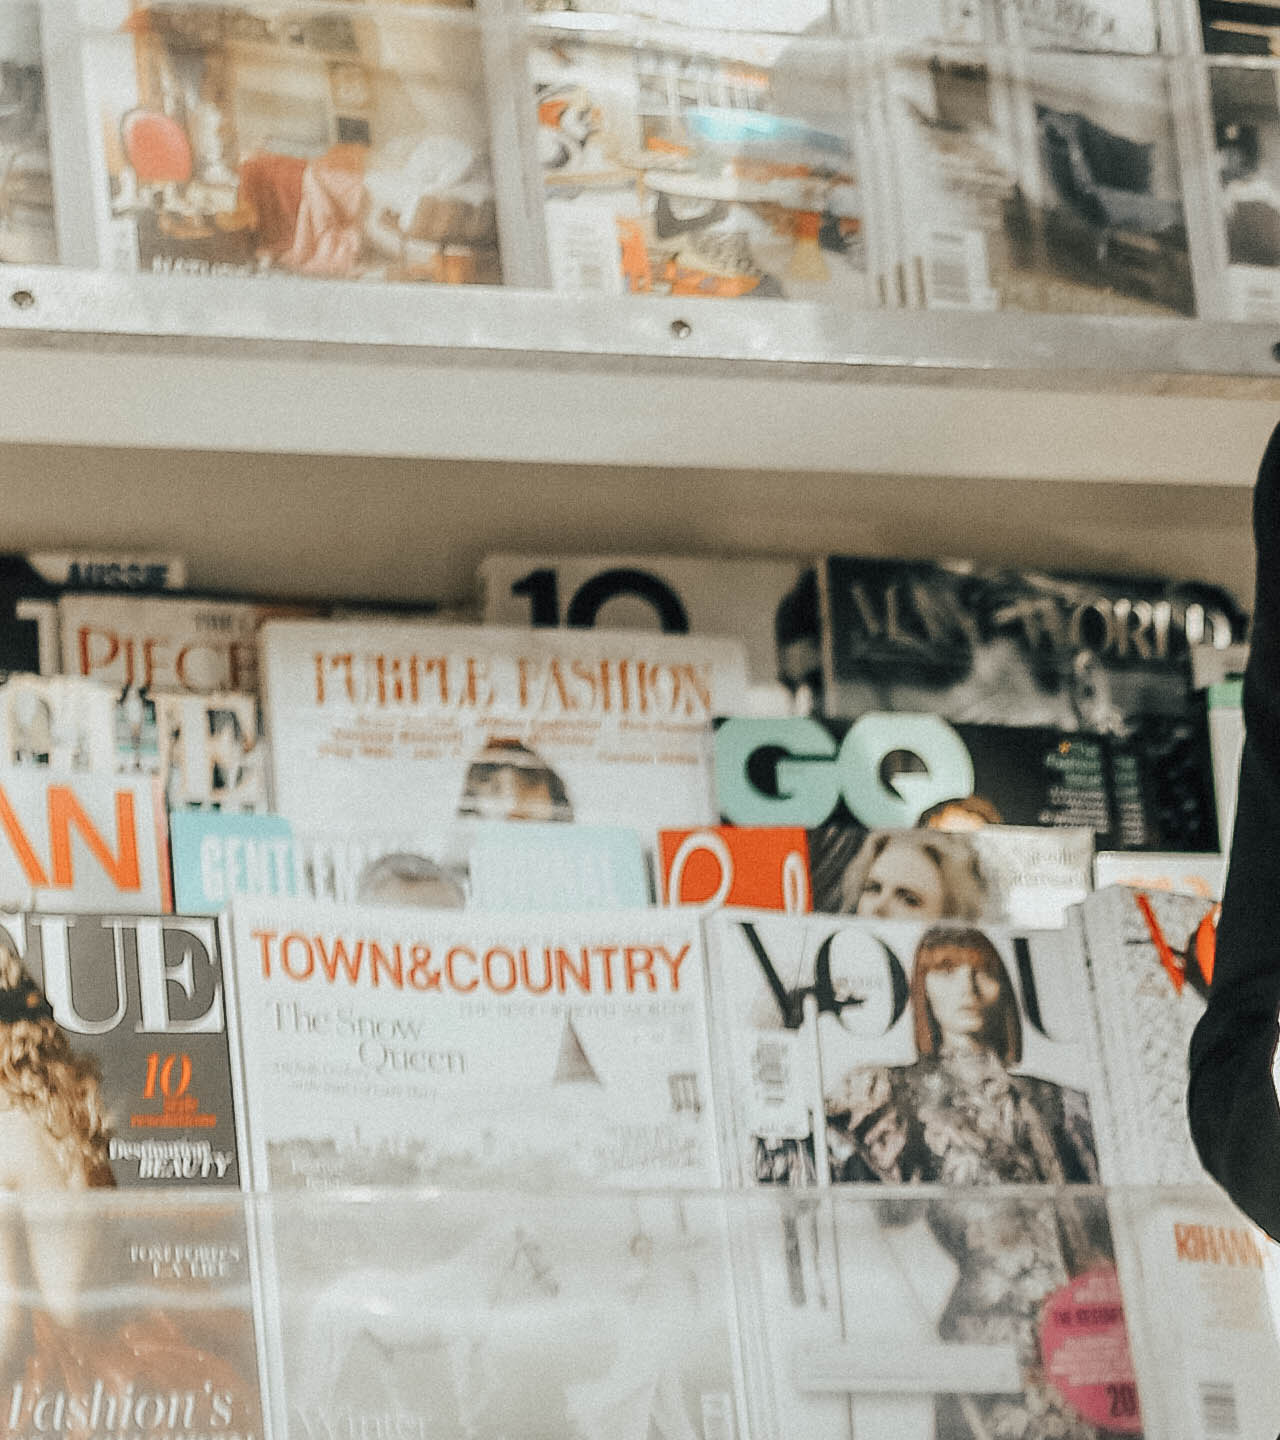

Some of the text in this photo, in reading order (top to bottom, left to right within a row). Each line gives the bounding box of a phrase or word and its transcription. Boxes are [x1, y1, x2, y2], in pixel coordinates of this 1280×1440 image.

[312, 651, 712, 712] PURPLE FASHION
[715, 711, 975, 831] GQ
[251, 929, 690, 996] TOWN&COUNTRY
[143, 1051, 193, 1099] 10
